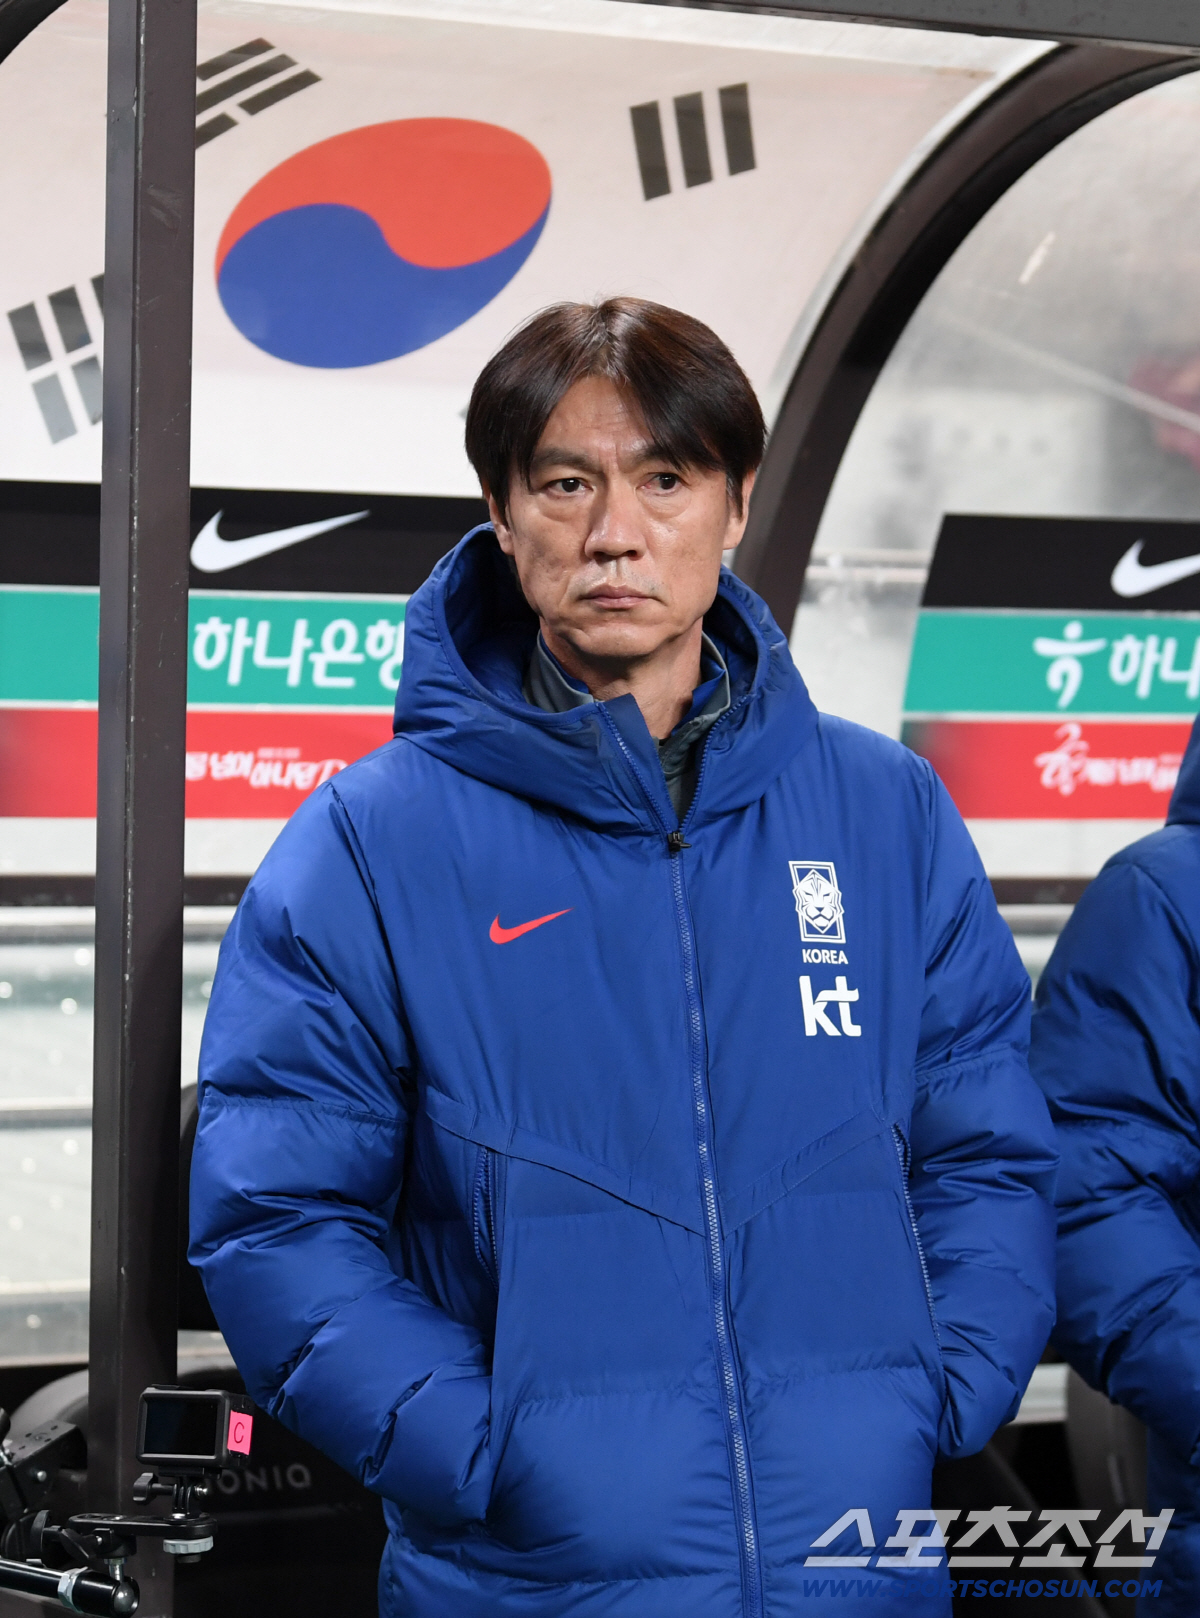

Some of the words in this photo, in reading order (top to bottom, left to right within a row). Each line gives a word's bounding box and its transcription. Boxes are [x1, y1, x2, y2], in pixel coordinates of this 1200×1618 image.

[193, 616, 405, 692] 하나은행
[802, 948, 849, 965] KOREA
[799, 975, 862, 1037] kt
[233, 1421, 244, 1444] C
